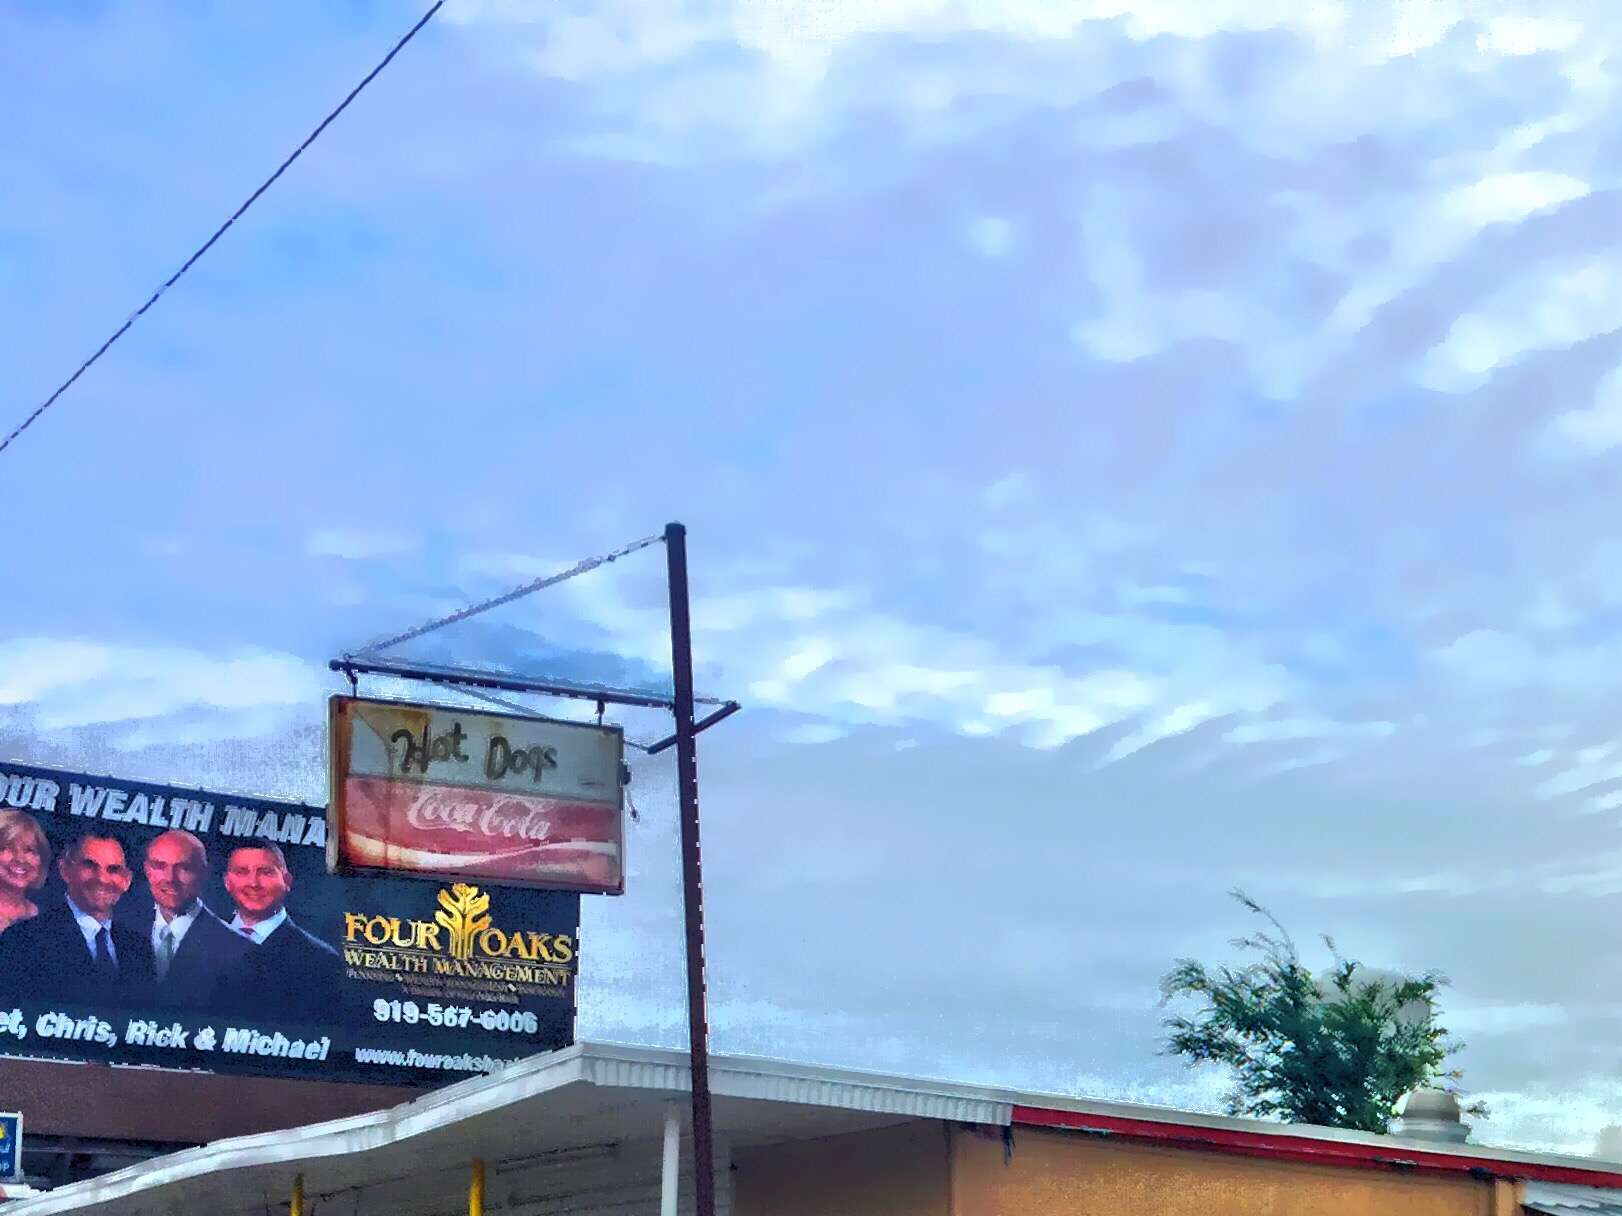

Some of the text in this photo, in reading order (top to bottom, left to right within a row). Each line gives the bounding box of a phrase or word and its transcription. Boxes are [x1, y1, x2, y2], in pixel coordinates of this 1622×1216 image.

[485, 736, 559, 783] Dogs
[69, 782, 215, 833] WEALTH
[343, 911, 574, 964] FOUR OAKS
[344, 948, 428, 974] WEALTH
[433, 956, 573, 987] MANAGEMENT
[35, 1010, 118, 1048] Chris,
[124, 1018, 191, 1050] Rick
[193, 1025, 217, 1052] &
[221, 1027, 332, 1061] Michael
